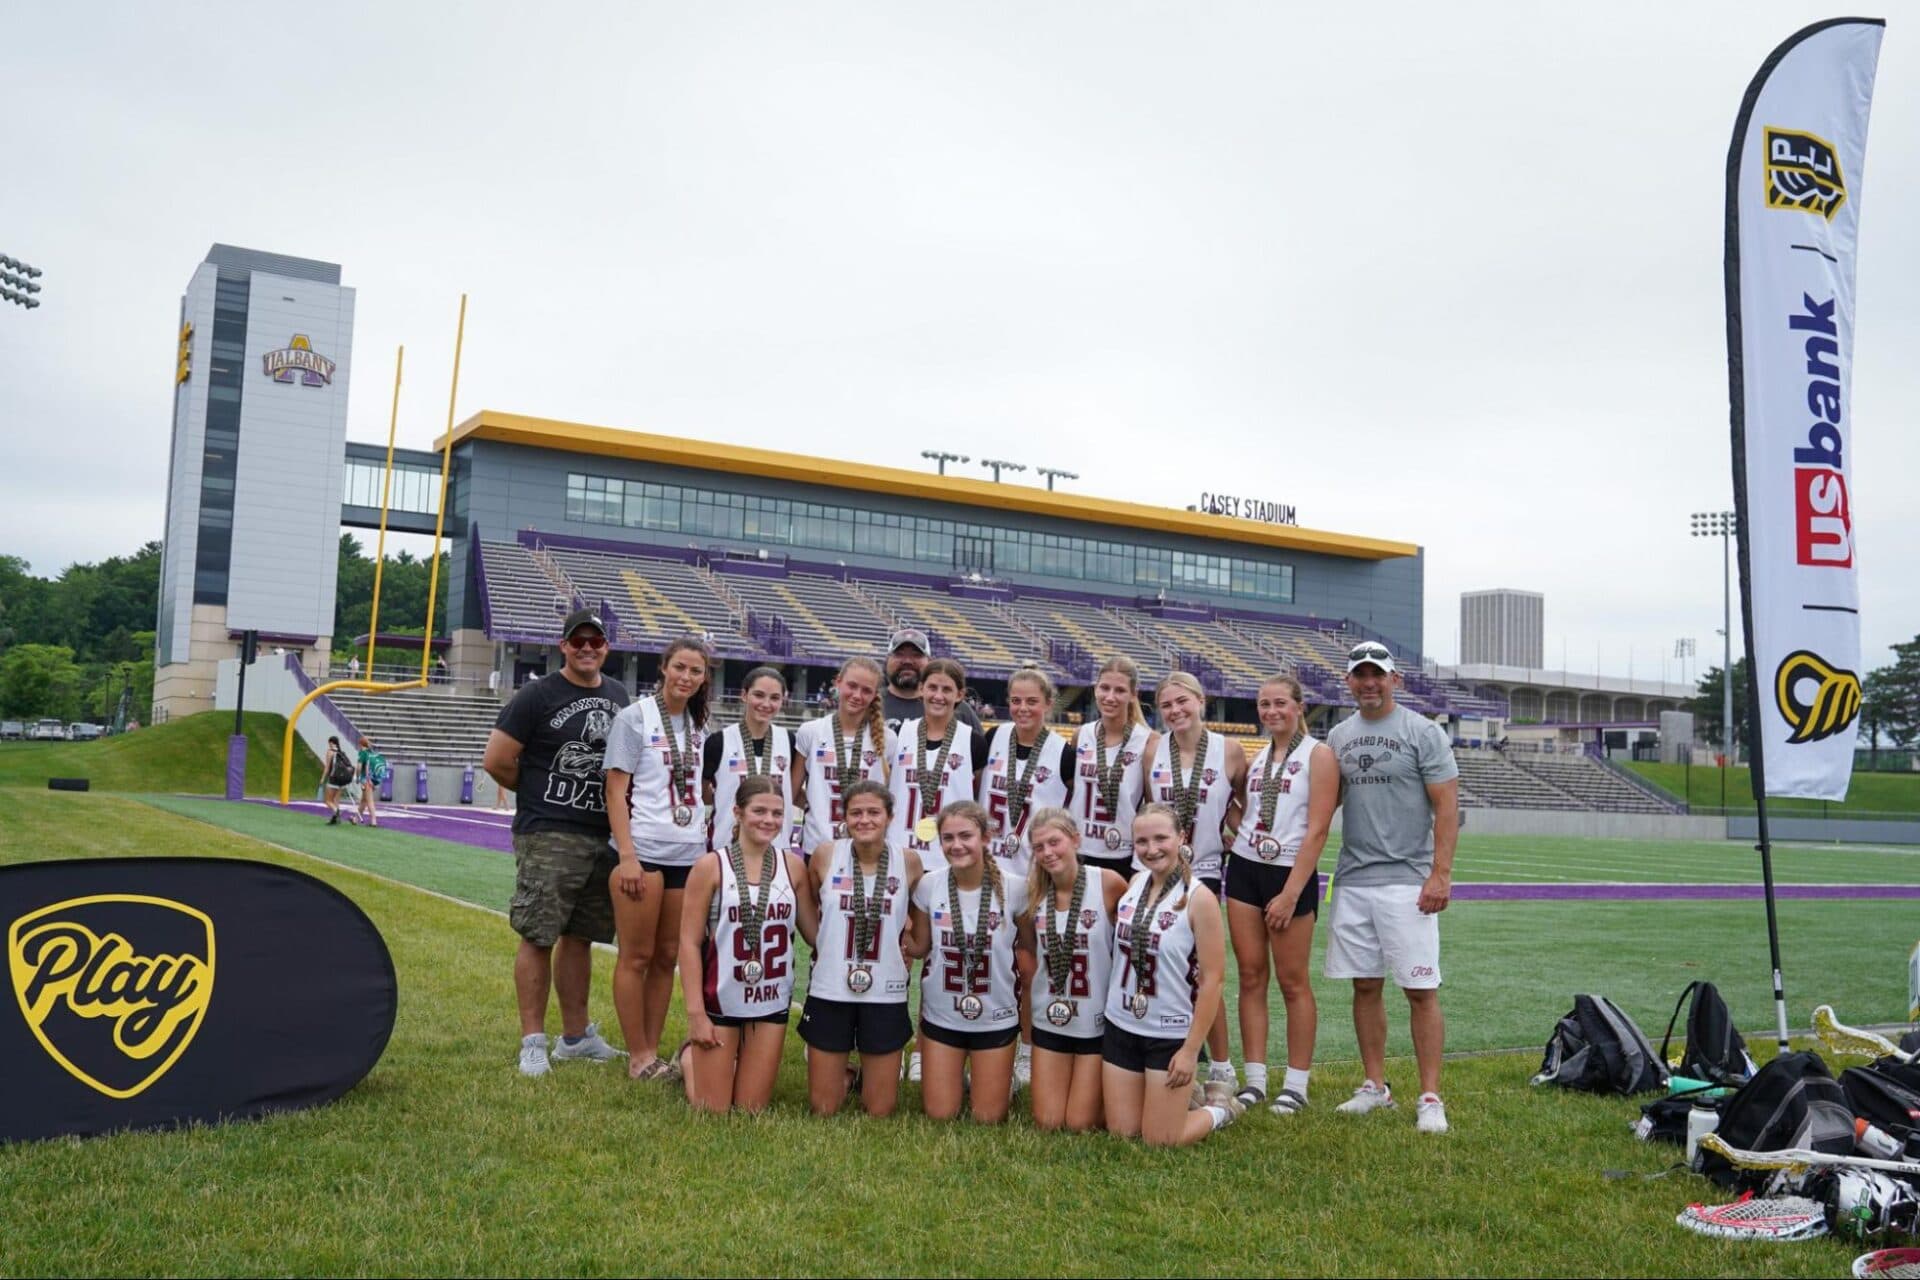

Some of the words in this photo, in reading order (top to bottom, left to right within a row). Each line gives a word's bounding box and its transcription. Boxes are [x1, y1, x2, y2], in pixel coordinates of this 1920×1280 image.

[264, 349, 335, 384] UALBANY
[1201, 492, 1240, 517] CASEY
[1244, 499, 1296, 525] STADIUM
[1377, 736, 1401, 753] PARK
[544, 772, 608, 811] DA
[733, 924, 788, 982] 92
[22, 930, 199, 1048] Play
[943, 950, 992, 995] 22
[744, 983, 779, 1003] PARK
